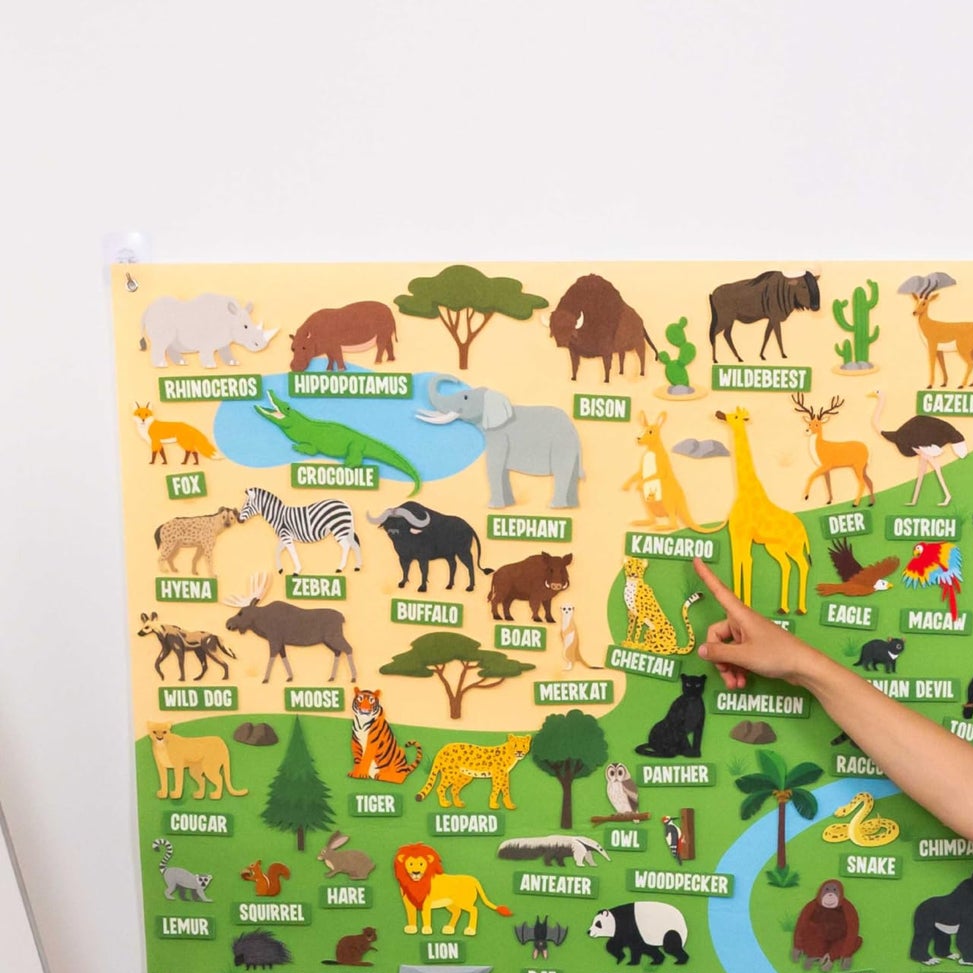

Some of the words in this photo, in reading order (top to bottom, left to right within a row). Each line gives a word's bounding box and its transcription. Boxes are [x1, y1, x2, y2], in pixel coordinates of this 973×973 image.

[165, 377, 257, 398] RHINOCEROS
[295, 375, 407, 394] HIPPOPOTAMUS
[720, 369, 806, 388] WILDEBEEST
[580, 397, 625, 417] BISON
[173, 475, 200, 495] FOX
[298, 466, 373, 486] CROCODILE
[494, 517, 566, 538] ELEPHANT
[829, 512, 865, 534] DEER
[894, 517, 955, 536] OSTRICH
[632, 534, 713, 558] KANGAROO
[162, 581, 211, 598] HYENA
[292, 577, 341, 596] ZEBRA
[398, 601, 459, 623] BUFFALO
[828, 604, 871, 625] EAGLE
[909, 612, 966, 630] MACAW
[501, 628, 541, 647] BOAR
[611, 649, 674, 677] CHEETAH
[164, 690, 198, 706] WILD
[204, 690, 232, 706] DOG
[291, 689, 339, 707] MOOSE
[540, 683, 607, 700] MEERKAT
[916, 681, 953, 697] DEVIL
[717, 692, 802, 713] CHAMELEON
[644, 766, 708, 783] PANTHER
[356, 795, 395, 812] TIGER
[171, 814, 227, 832] COUGAR
[436, 815, 497, 832] LEOPARD
[612, 829, 639, 847] OWL
[848, 855, 895, 874] SNAKE
[520, 874, 591, 894] ANTEATER
[635, 871, 728, 893] WOODPECKER
[328, 887, 365, 904] HARE
[240, 904, 304, 922] SQUIRREL
[163, 918, 208, 935] LEMUR
[428, 943, 458, 959] LION
